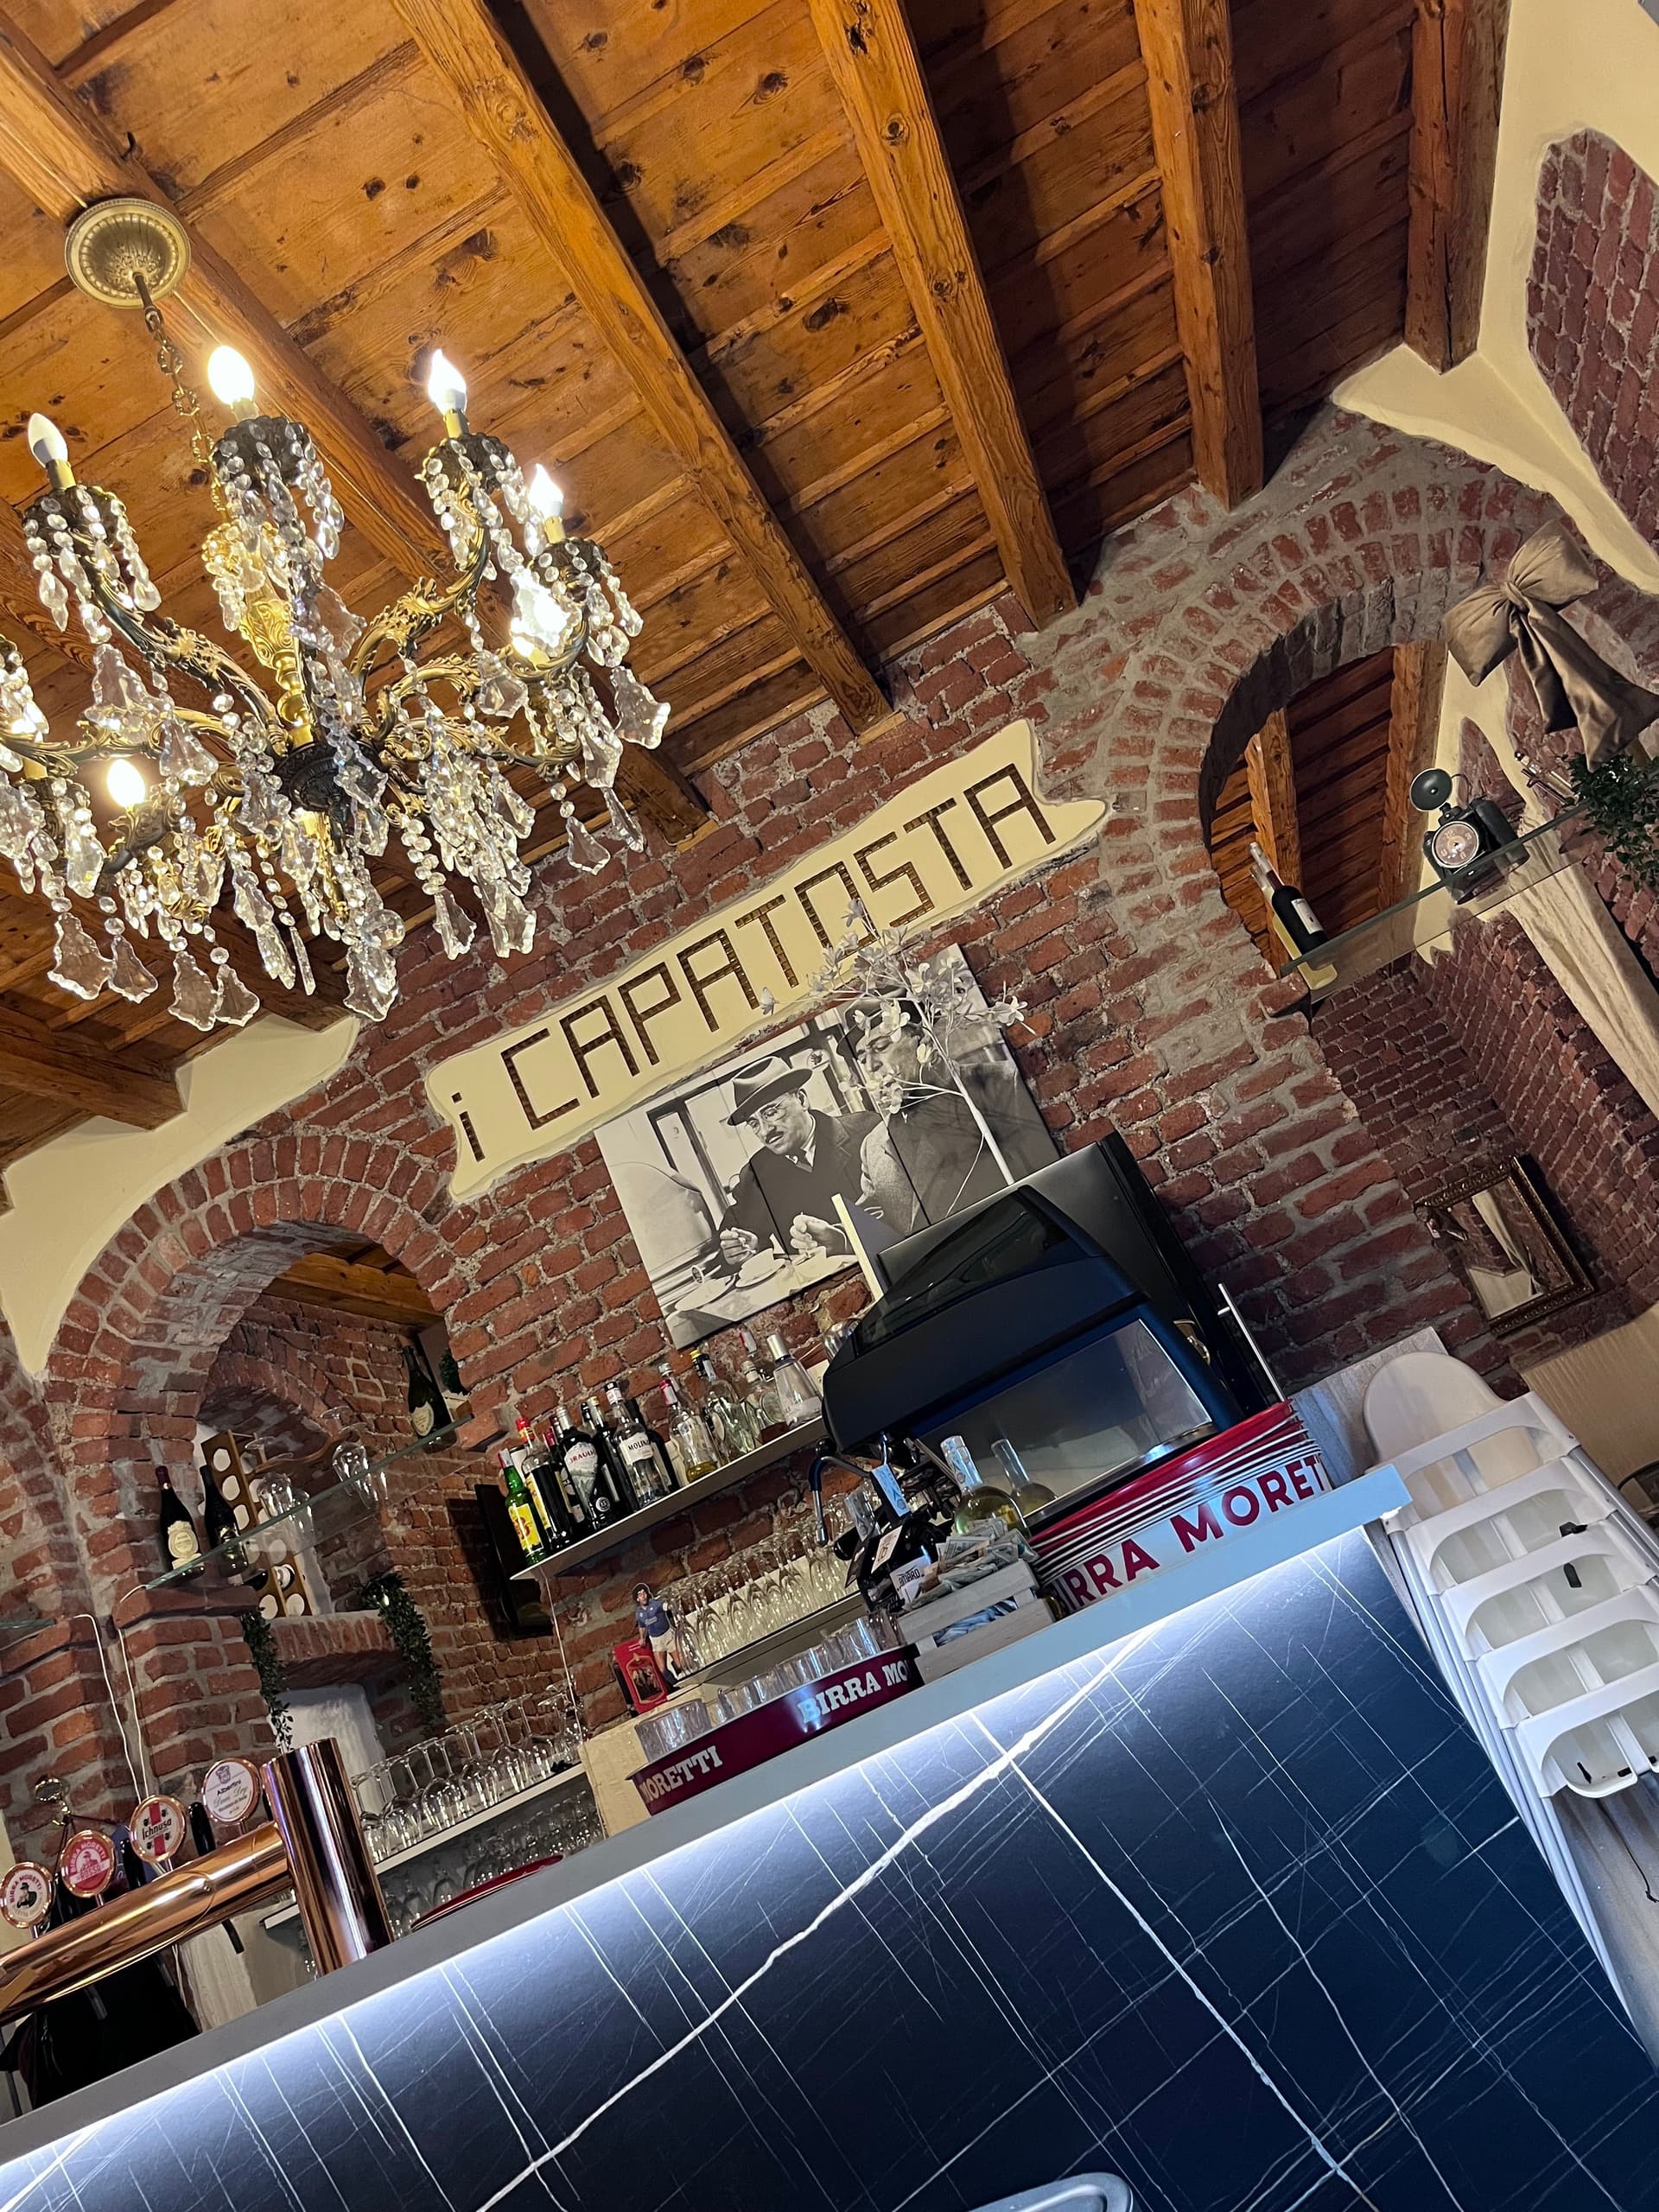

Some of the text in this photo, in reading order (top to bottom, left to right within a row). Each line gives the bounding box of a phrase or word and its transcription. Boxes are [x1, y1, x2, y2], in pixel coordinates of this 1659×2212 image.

[500, 762, 1056, 1131] CAPATOSTA
[1170, 1453, 1325, 1554] MORET
[797, 1659, 909, 1726] BIRRA MO
[142, 1818, 172, 1840] Ichnusa
